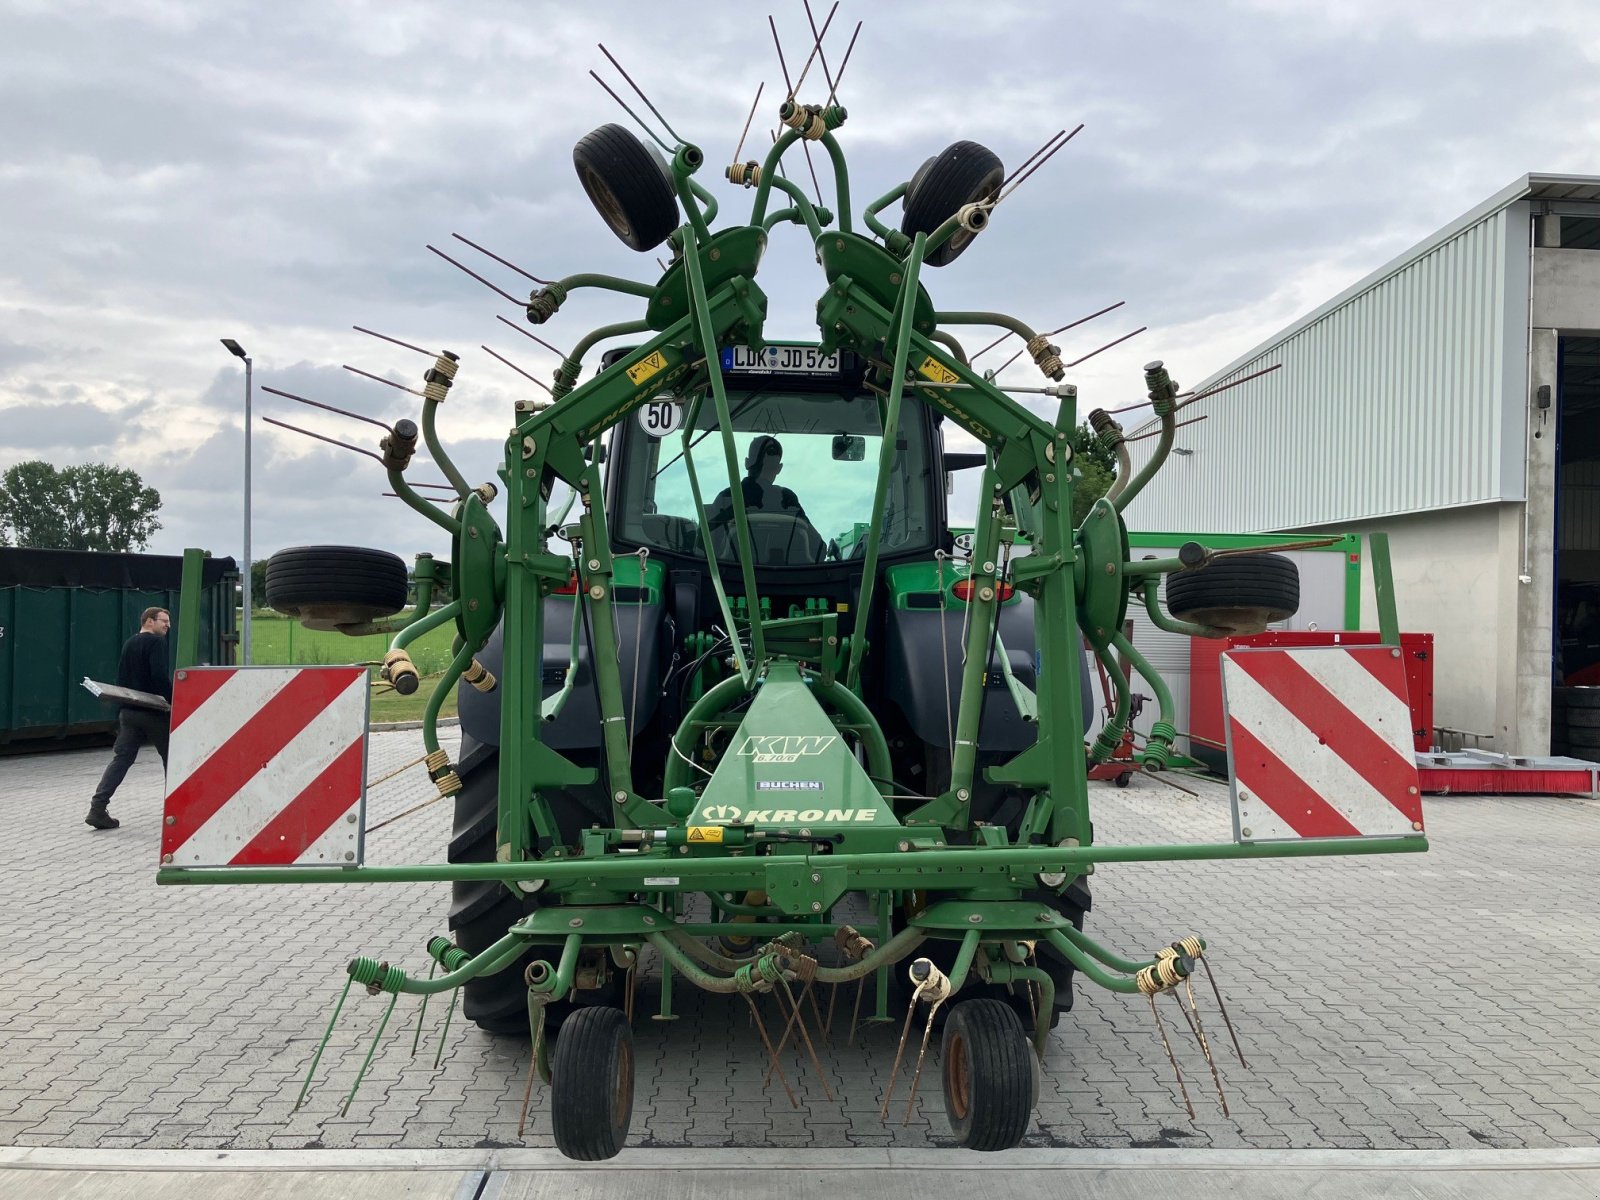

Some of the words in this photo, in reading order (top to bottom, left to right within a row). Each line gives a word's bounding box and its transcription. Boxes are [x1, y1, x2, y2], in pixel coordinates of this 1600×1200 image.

[734, 348, 768, 367] LDK
[781, 349, 802, 369] JD
[806, 350, 838, 369] 575
[647, 402, 673, 430] 50
[737, 735, 837, 756] KW
[757, 753, 796, 762] 6.70/6
[744, 808, 878, 823] KRONE
